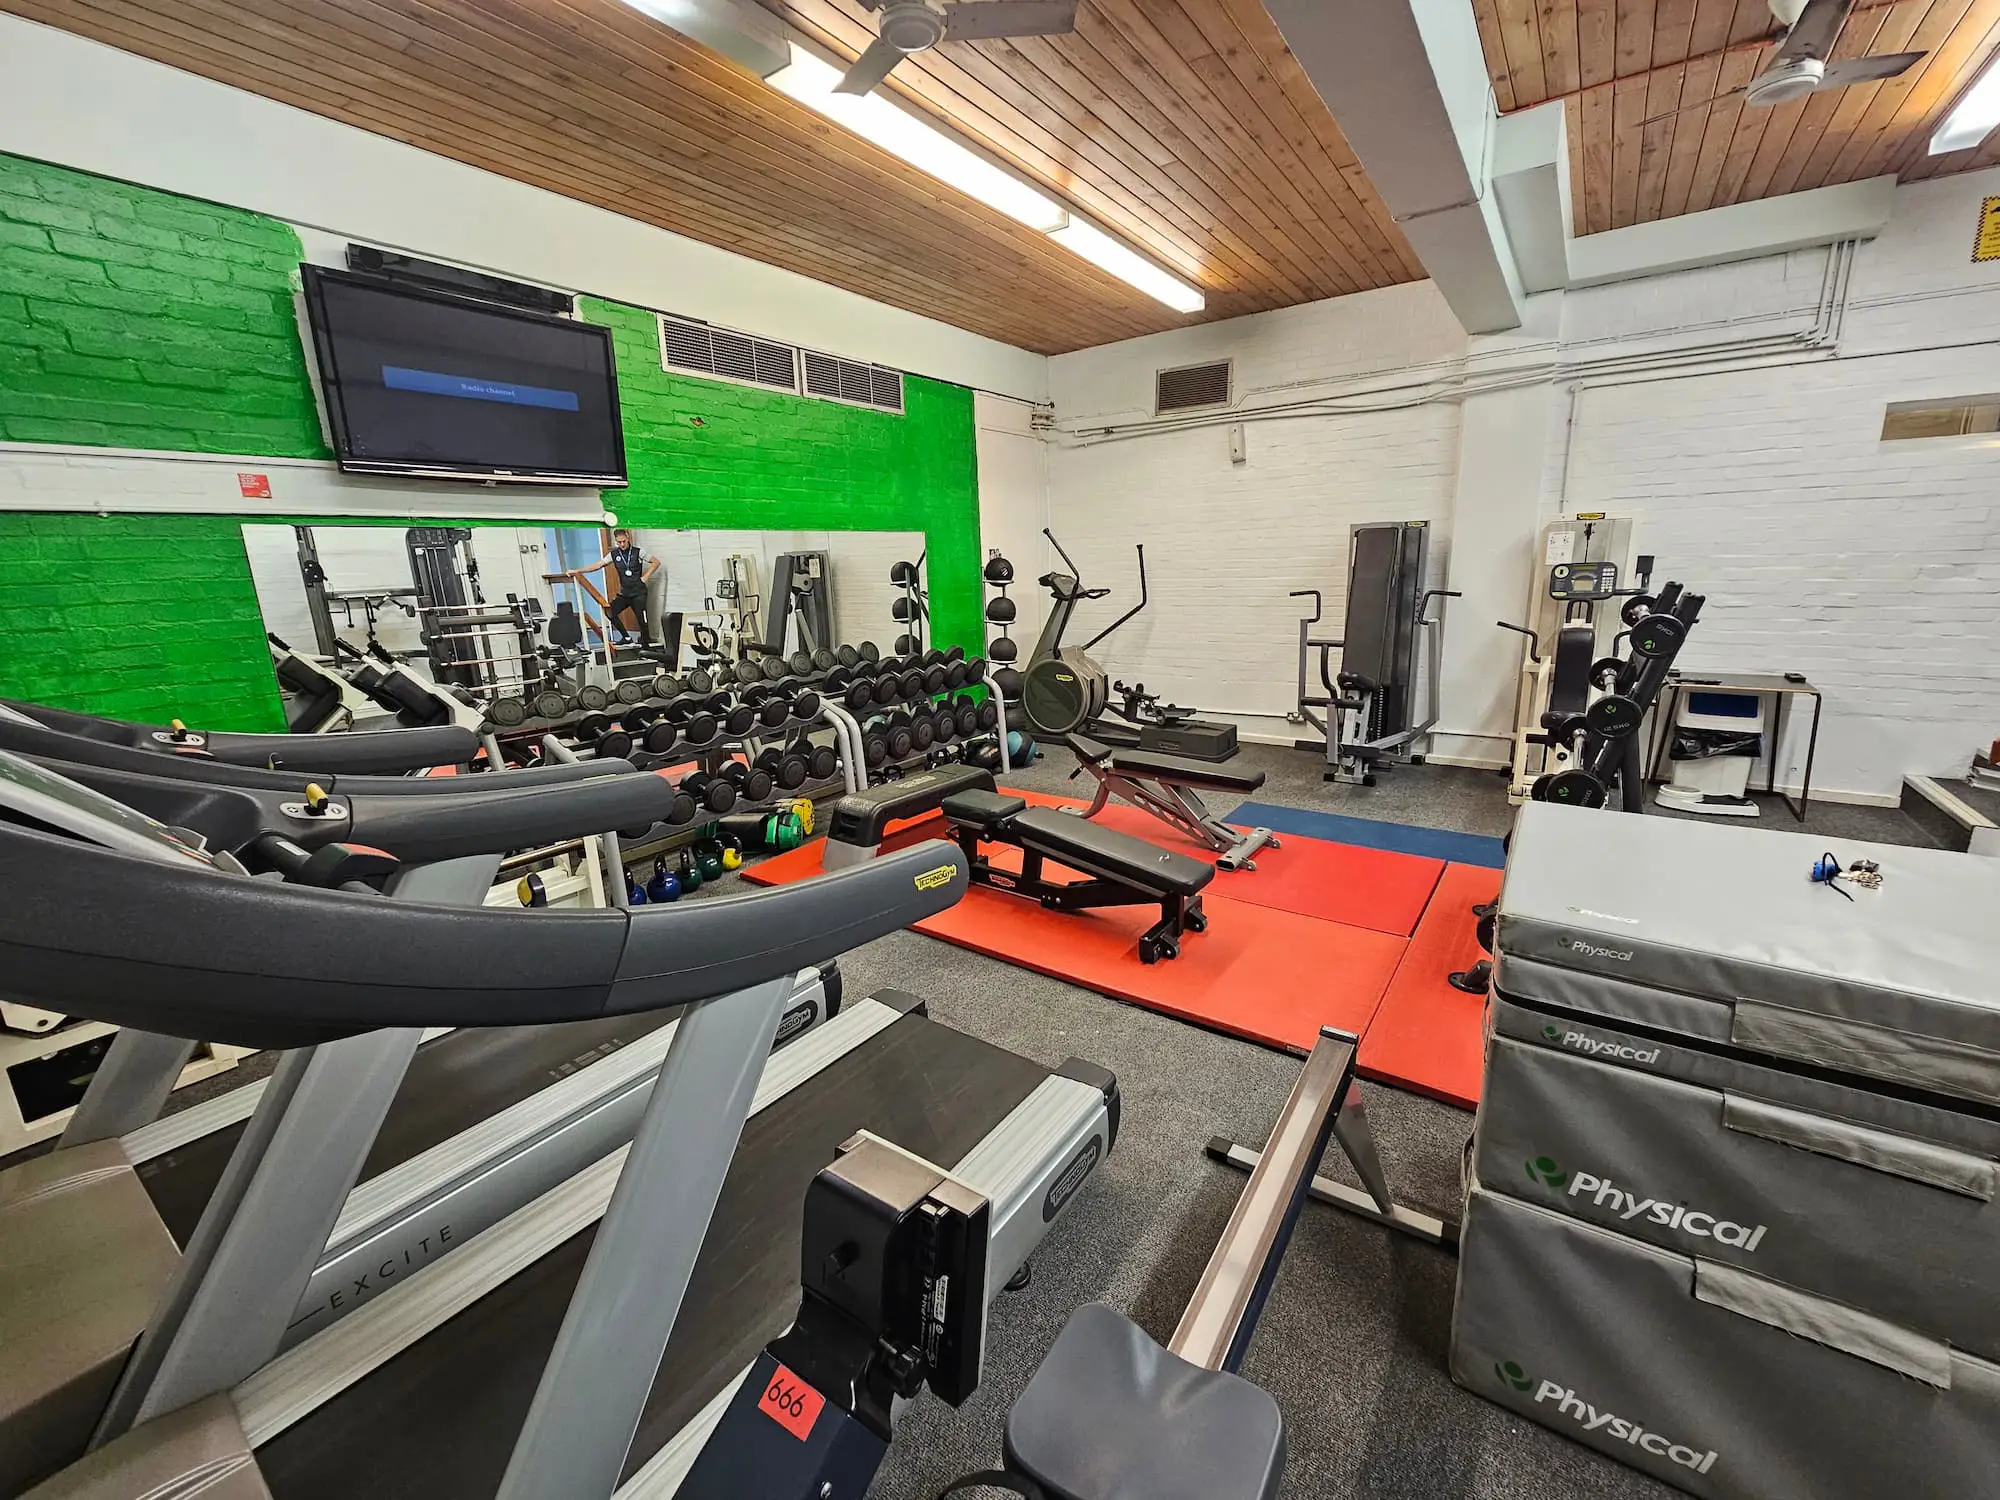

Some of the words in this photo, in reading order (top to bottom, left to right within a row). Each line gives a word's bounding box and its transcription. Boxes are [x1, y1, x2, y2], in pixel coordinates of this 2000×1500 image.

[1571, 940, 1634, 961] Physical
[1562, 1030, 1661, 1065] Physical
[1567, 1171, 1769, 1253] Physical
[329, 1224, 453, 1310] EXCITE
[767, 1378, 807, 1418] 666
[1533, 1379, 1719, 1475] Physical
